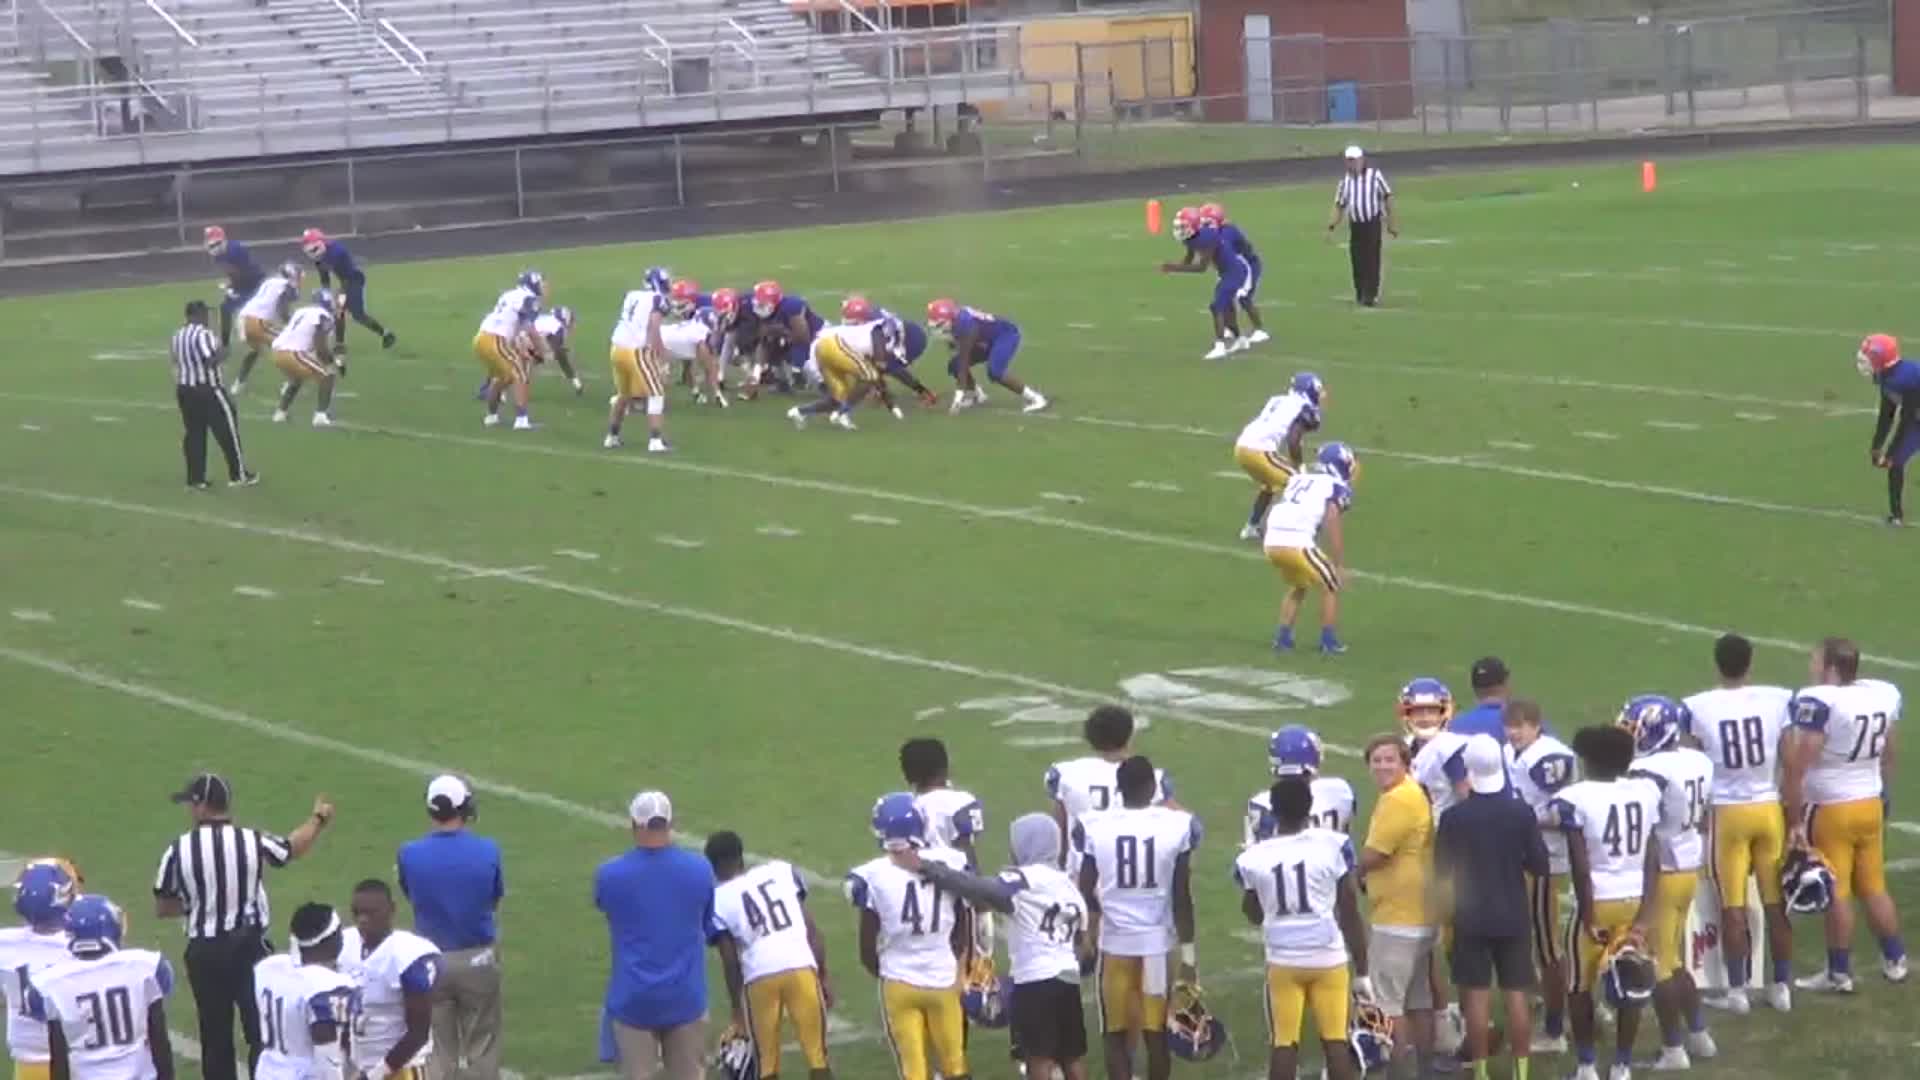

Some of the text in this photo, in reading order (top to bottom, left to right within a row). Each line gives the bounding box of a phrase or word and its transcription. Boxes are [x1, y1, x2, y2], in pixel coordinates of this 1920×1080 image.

[1719, 715, 1766, 769] 88
[1848, 711, 1887, 763] 72
[1603, 801, 1643, 857] 48
[1116, 835, 1158, 889] 81
[1270, 860, 1313, 915] 11
[741, 878, 793, 938] 46
[75, 986, 134, 1049] 30
